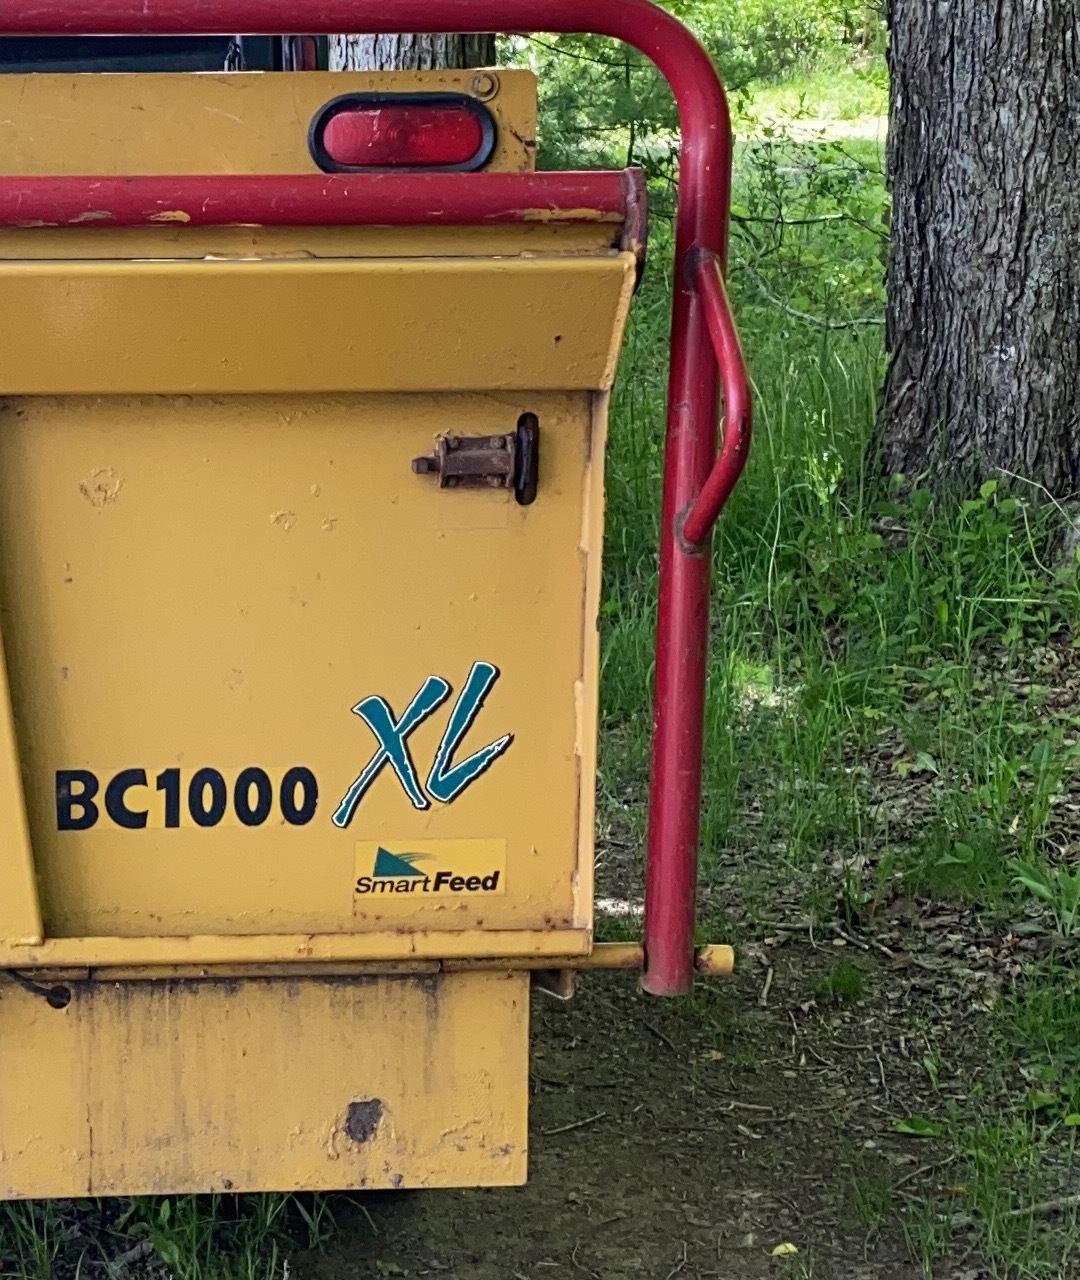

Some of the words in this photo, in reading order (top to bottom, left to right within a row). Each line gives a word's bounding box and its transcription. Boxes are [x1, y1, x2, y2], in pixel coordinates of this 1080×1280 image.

[55, 766, 318, 831] BC1000
[331, 660, 515, 828] XL
[354, 870, 500, 893] SmartFeed
